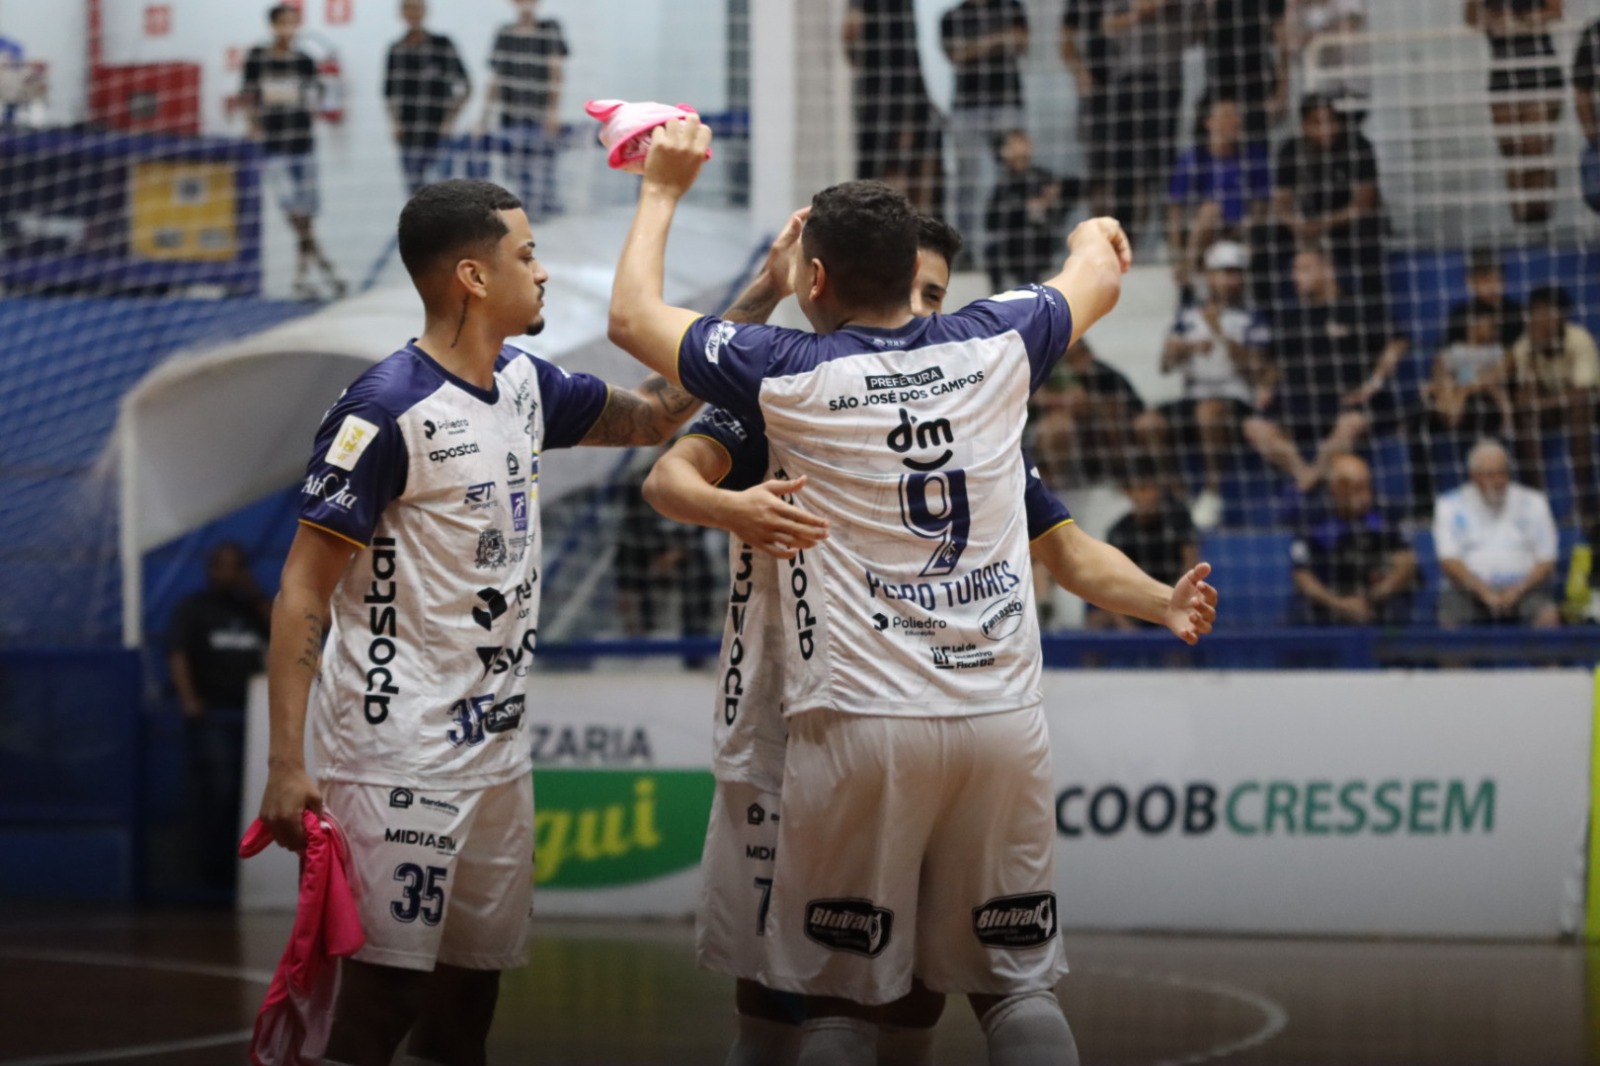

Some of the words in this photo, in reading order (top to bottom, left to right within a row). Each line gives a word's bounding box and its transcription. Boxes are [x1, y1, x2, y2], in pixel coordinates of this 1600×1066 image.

[829, 396, 859, 411] SÃO
[863, 390, 897, 406] JOSÉ
[900, 389, 928, 402] DOS
[930, 370, 984, 396] CAMPOS
[429, 441, 480, 463] apostal
[898, 469, 971, 578] 9
[940, 560, 1020, 608] TURRES
[364, 537, 400, 725] apostal
[893, 616, 947, 629] Poliedro
[956, 661, 979, 669] Fiscal
[390, 863, 447, 926] 35
[754, 877, 773, 936] 7
